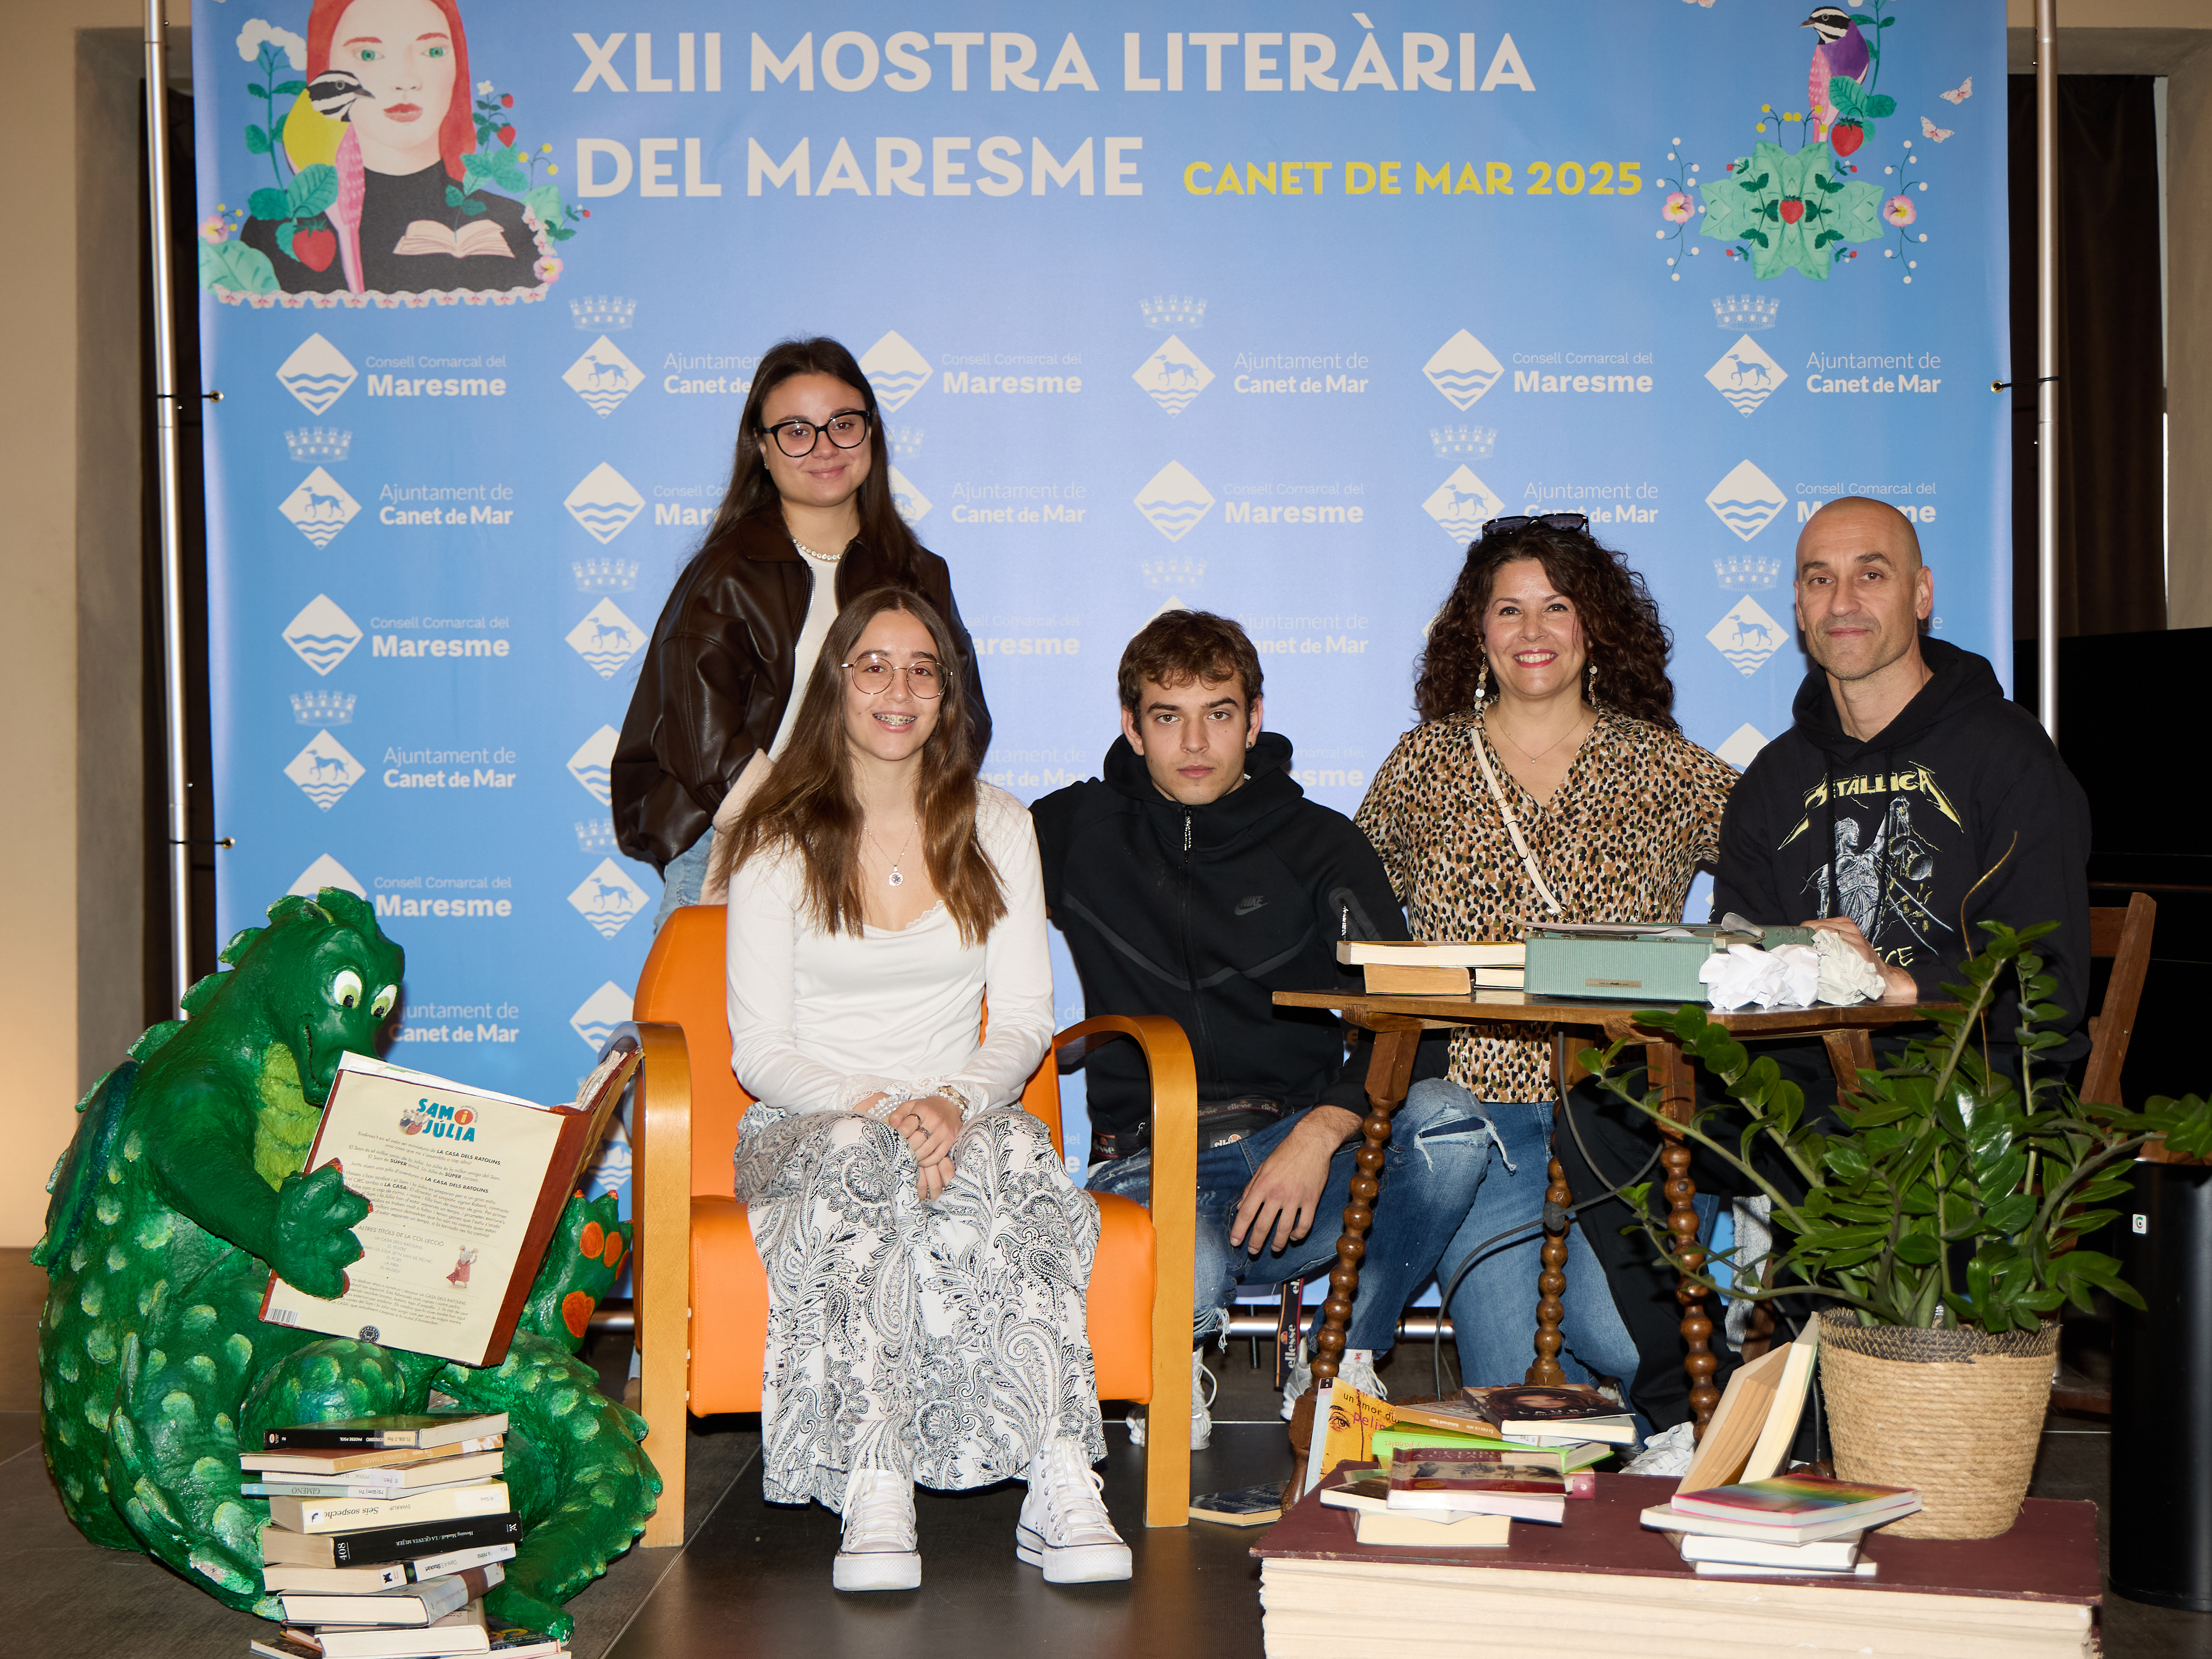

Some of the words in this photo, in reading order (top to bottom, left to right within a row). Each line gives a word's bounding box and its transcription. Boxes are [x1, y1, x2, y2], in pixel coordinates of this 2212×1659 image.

[572, 32, 721, 92] XLII
[750, 30, 1100, 92] MOSTRA
[1124, 13, 1536, 92] LITERÀRIA
[576, 137, 722, 197] DEL
[747, 135, 1143, 197] MARESME
[1183, 161, 1332, 196] CANET
[1345, 161, 1402, 195] DE
[1415, 161, 1514, 195] MAR
[1526, 161, 1643, 196] 2025
[366, 355, 415, 368] Consell
[418, 355, 482, 368] Comarcal
[485, 355, 507, 367] del
[941, 354, 990, 365] Consell
[995, 354, 1058, 365] Comarcal
[1062, 353, 1082, 365] del
[1234, 352, 1341, 372] Ajuntament
[1346, 352, 1369, 369] de
[1513, 352, 1561, 364] Consell
[1566, 352, 1629, 364] Comarcal
[1633, 352, 1653, 364] del
[1806, 352, 1914, 372] Ajuntament
[1919, 352, 1941, 369] de
[367, 374, 507, 396] Maresme
[664, 375, 727, 393] Canet
[730, 378, 751, 393] de
[943, 372, 1082, 393] Maresme
[1234, 375, 1297, 393] Canet
[1300, 377, 1322, 393] de
[1326, 374, 1369, 393] Mar
[1514, 370, 1653, 393] Maresme
[1806, 375, 1870, 393] Canet
[1872, 377, 1895, 393] de
[1898, 374, 1941, 393] Mar
[379, 483, 488, 504] Ajuntament
[491, 483, 514, 501] de
[653, 485, 702, 497] Consell
[952, 482, 1060, 503] Ajuntament
[1063, 481, 1087, 499] de
[1224, 483, 1272, 495] Consell
[1277, 483, 1340, 495] Comarcal
[1344, 482, 1364, 494] del
[1524, 482, 1631, 502] Ajuntament
[1636, 481, 1658, 499] de
[1796, 483, 1845, 494] Consell
[1848, 483, 1911, 494] Comarcal
[1916, 482, 1936, 494] del
[379, 506, 442, 525] Canet
[445, 508, 468, 525] de
[470, 506, 514, 524] Mar
[951, 505, 1014, 523] Canet
[1017, 507, 1039, 523] de
[1043, 504, 1086, 523] Mar
[1225, 502, 1364, 523] Maresme
[1590, 507, 1612, 523] de
[1616, 504, 1658, 523] Mar
[370, 617, 419, 629] Consell
[422, 617, 486, 629] Comarcal
[489, 616, 510, 628] del
[993, 615, 1058, 627] Comarcal
[1060, 614, 1080, 626] del
[1346, 613, 1368, 629] de
[372, 635, 510, 657] Maresme
[973, 636, 1080, 655] aresme
[1252, 636, 1297, 654] anet
[1300, 638, 1322, 654] de
[1325, 635, 1369, 654] Mar
[383, 747, 491, 767] Ajuntament
[493, 747, 516, 764] de
[1063, 746, 1087, 763] de
[1296, 747, 1340, 759] marcal
[1344, 747, 1365, 758] del
[383, 769, 446, 788] Canet
[448, 772, 470, 788] de
[474, 769, 517, 787] Mar
[980, 769, 1014, 787] net
[1018, 772, 1040, 786] de
[1044, 768, 1087, 786] Mar
[374, 877, 422, 889] Consell
[426, 877, 488, 888] Comarcal
[492, 876, 512, 888] del
[375, 895, 512, 917] Maresme
[1239, 896, 1264, 907] NIKE
[496, 1002, 519, 1019] de
[388, 1025, 450, 1043] Canet
[452, 1027, 474, 1042] de
[477, 1024, 519, 1042] Mar
[417, 1098, 455, 1121] SAM
[422, 1119, 475, 1142] JÚLIA
[474, 1156, 502, 1166] RATOLINS,
[378, 1228, 395, 1236] TÍTOLS
[1285, 1324, 1296, 1368] ellesse
[1343, 1393, 1354, 1403] un
[1356, 1400, 1382, 1416] amor
[1384, 1440, 1414, 1449] pañales
[361, 1456, 384, 1465] TAMARO
[384, 1452, 408, 1462] SUSANNA
[291, 1487, 320, 1495] GIMENO
[362, 1507, 379, 1515] Seis
[413, 1535, 431, 1544] QUINTA
[338, 1542, 347, 1560] 408
